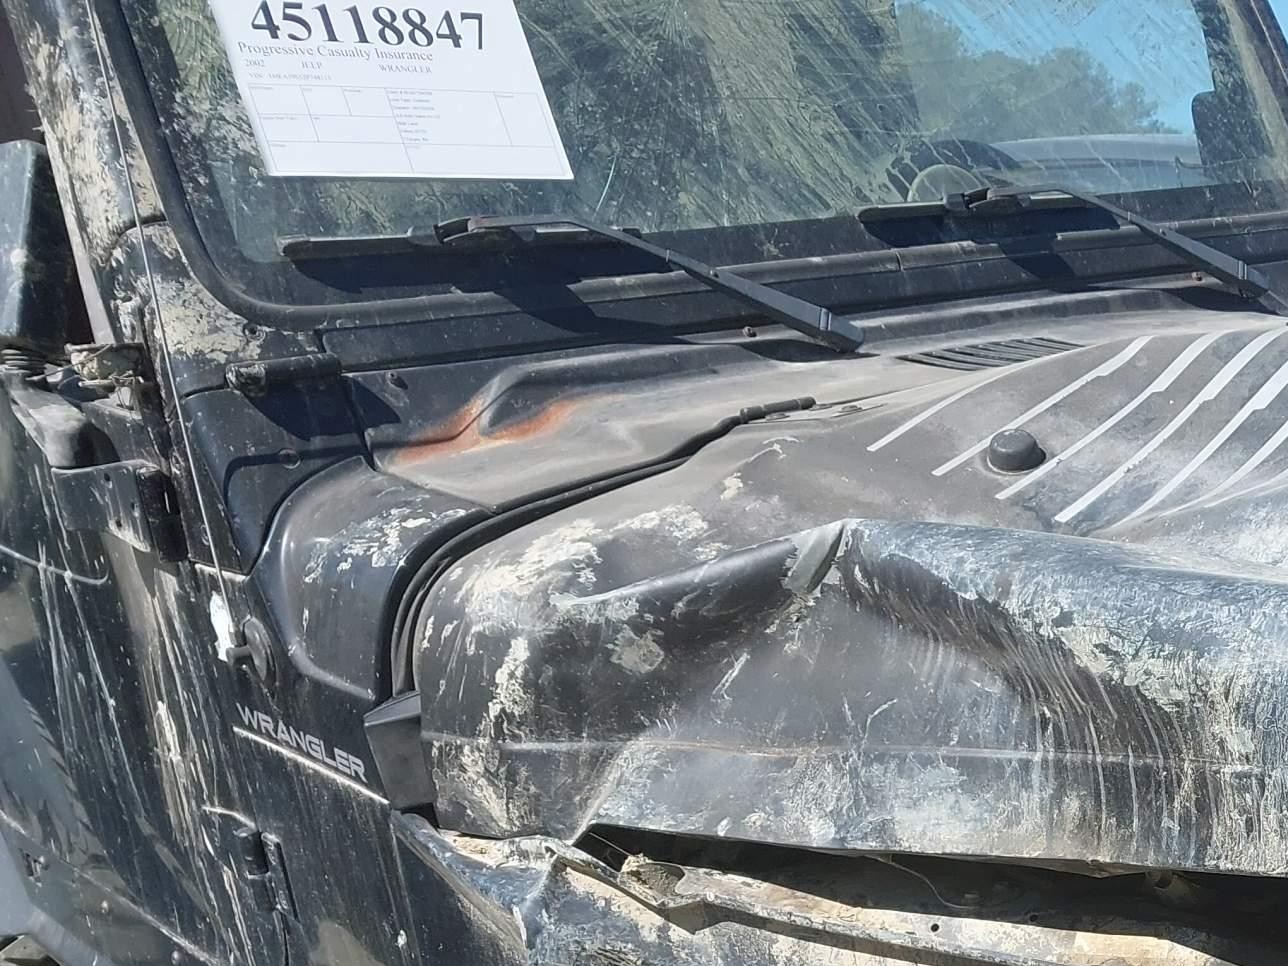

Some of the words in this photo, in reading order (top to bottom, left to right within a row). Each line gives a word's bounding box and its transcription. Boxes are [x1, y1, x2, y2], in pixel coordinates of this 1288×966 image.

[250, 0, 483, 50] 45118847
[238, 42, 316, 57] Progressive
[317, 46, 371, 62] Casualty
[375, 49, 434, 63] Insurance
[378, 64, 433, 74] WRANGLER
[236, 703, 368, 784] WRANGLER
